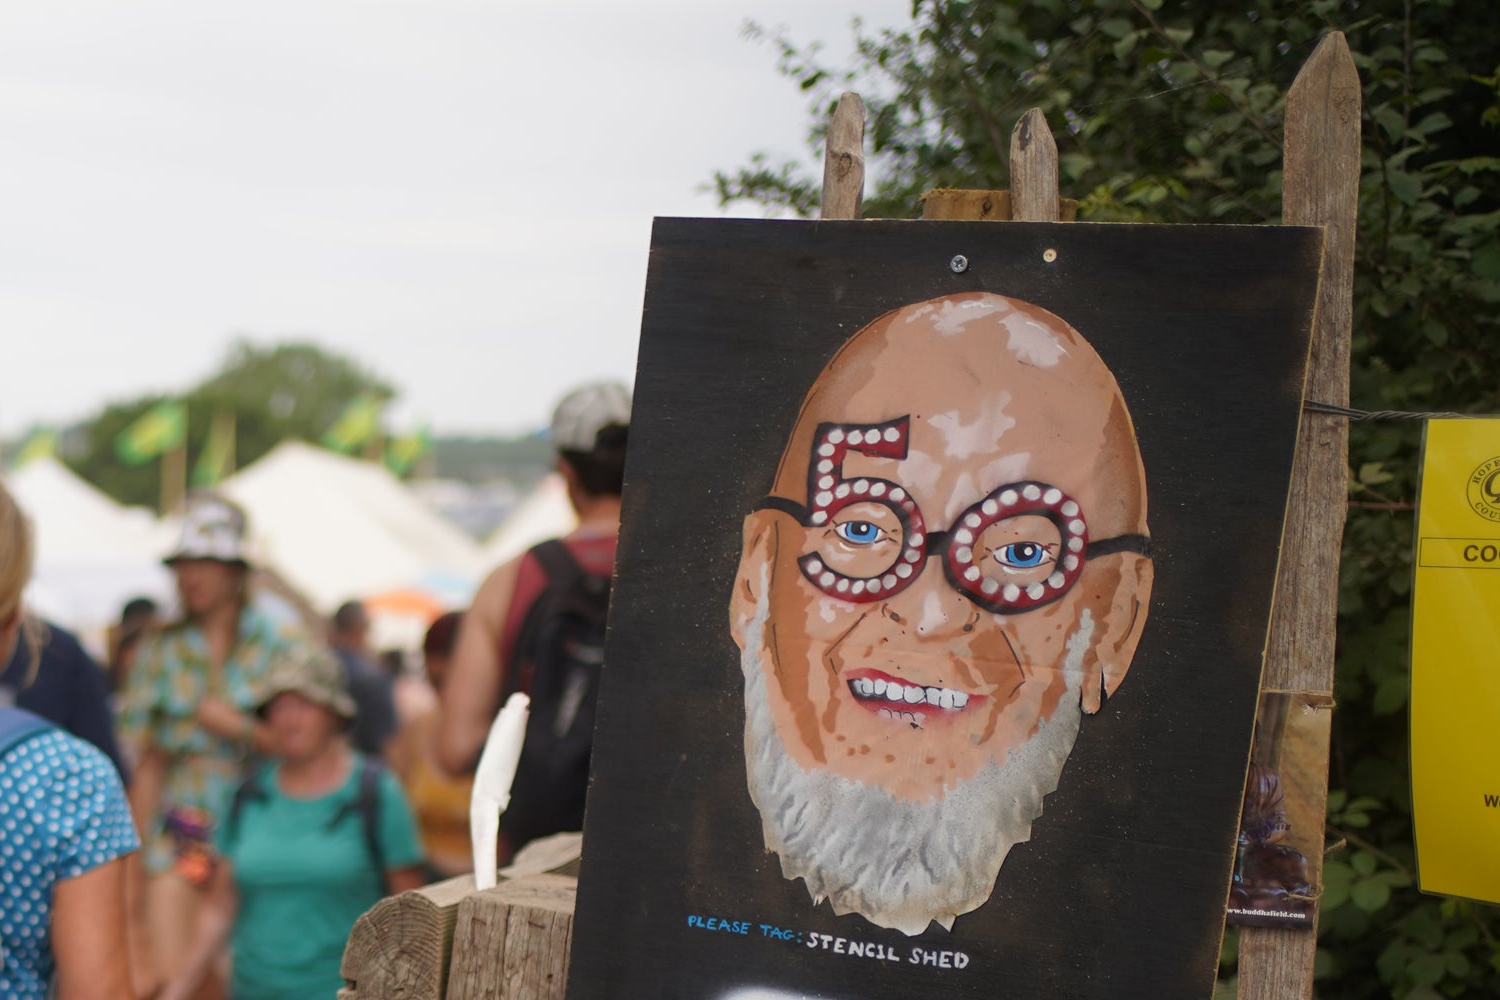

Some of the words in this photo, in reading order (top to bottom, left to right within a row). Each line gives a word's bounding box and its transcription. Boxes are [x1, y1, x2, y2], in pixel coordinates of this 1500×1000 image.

[1474, 502, 1500, 519] COU
[1463, 544, 1500, 563] CO
[1484, 793, 1500, 808] W
[1226, 908, 1306, 919] ww.buddhafield.com
[687, 915, 752, 934] PLEASE
[760, 924, 803, 943] TAG:
[806, 932, 901, 962] STENCIL
[908, 948, 970, 970] SHED
